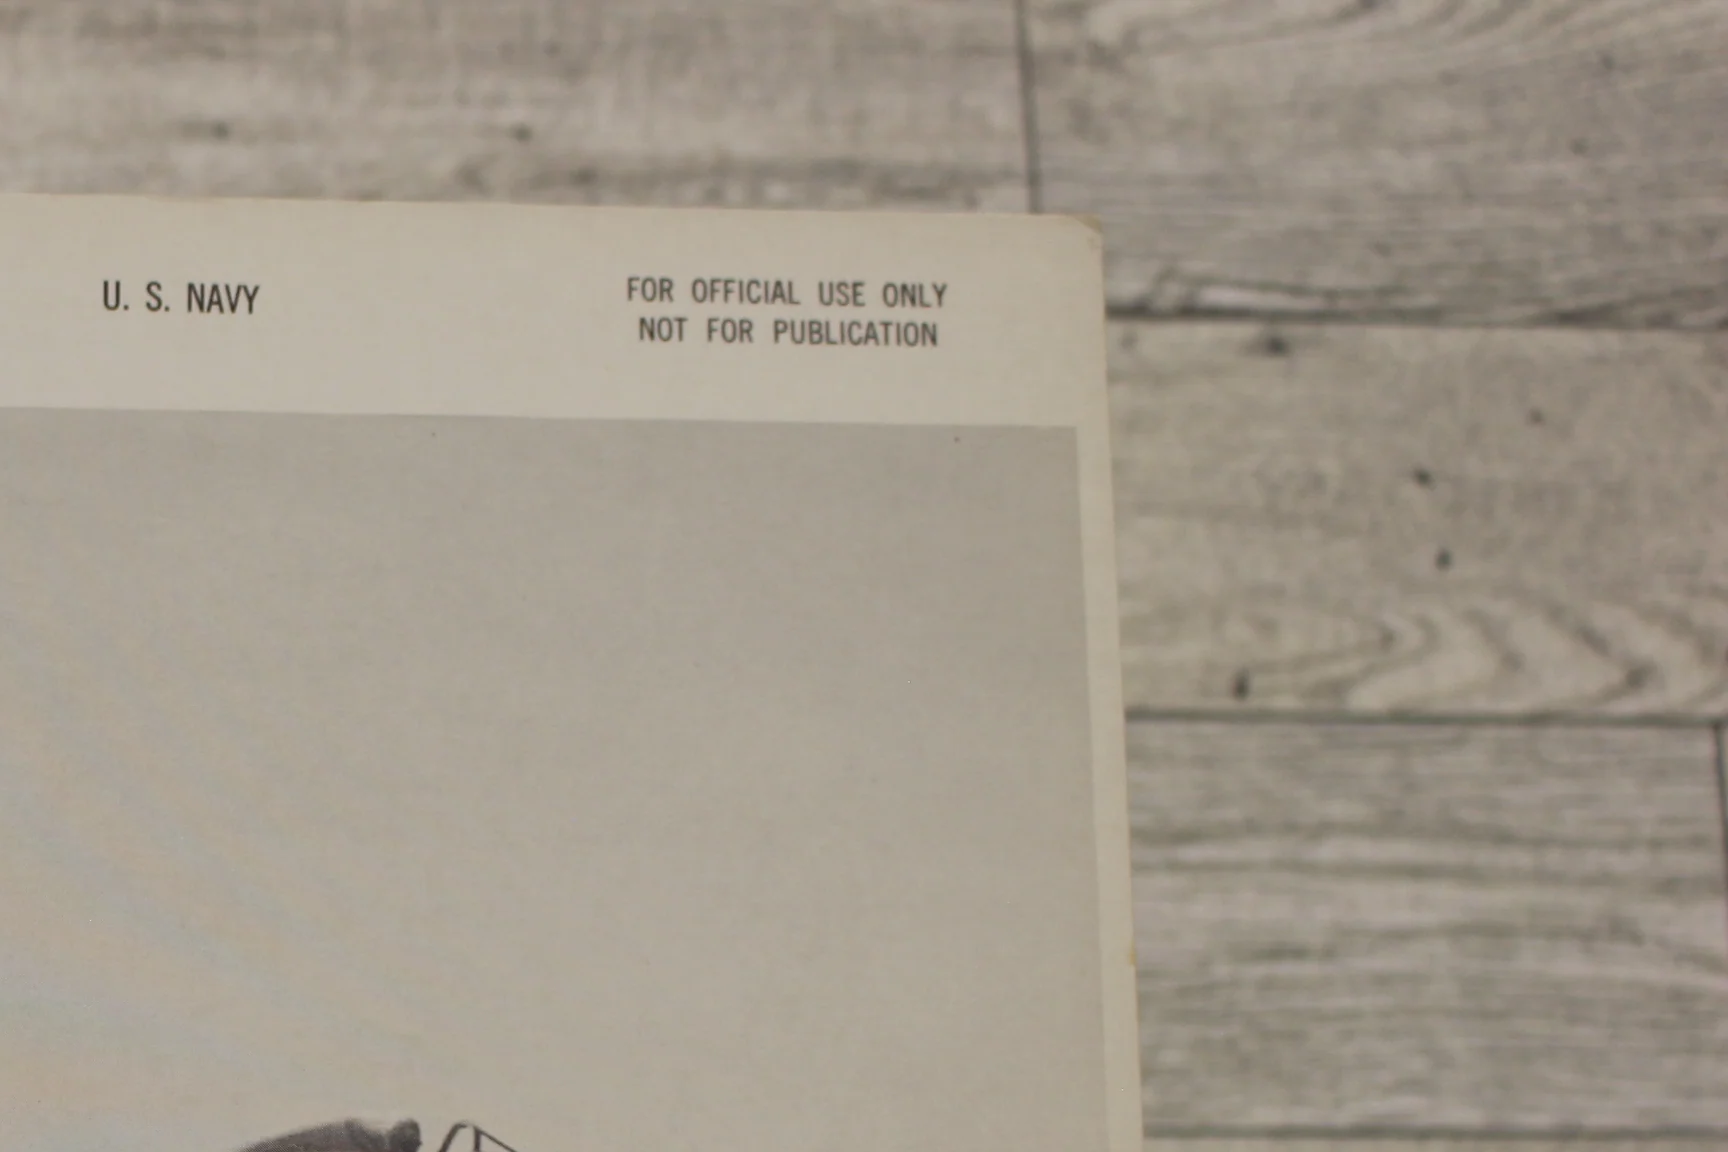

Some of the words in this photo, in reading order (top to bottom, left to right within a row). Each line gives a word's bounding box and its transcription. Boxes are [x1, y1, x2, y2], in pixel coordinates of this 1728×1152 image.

[103, 279, 130, 311] U.
[145, 280, 170, 313] S.
[187, 282, 260, 315] NAVY
[627, 276, 674, 303] FOR
[691, 278, 800, 305] OFFICIAL
[818, 281, 865, 307] USE
[882, 282, 947, 308] ONLY
[639, 317, 687, 342] NOT
[707, 317, 754, 344] FOR
[773, 319, 938, 347] PUBLICATION
